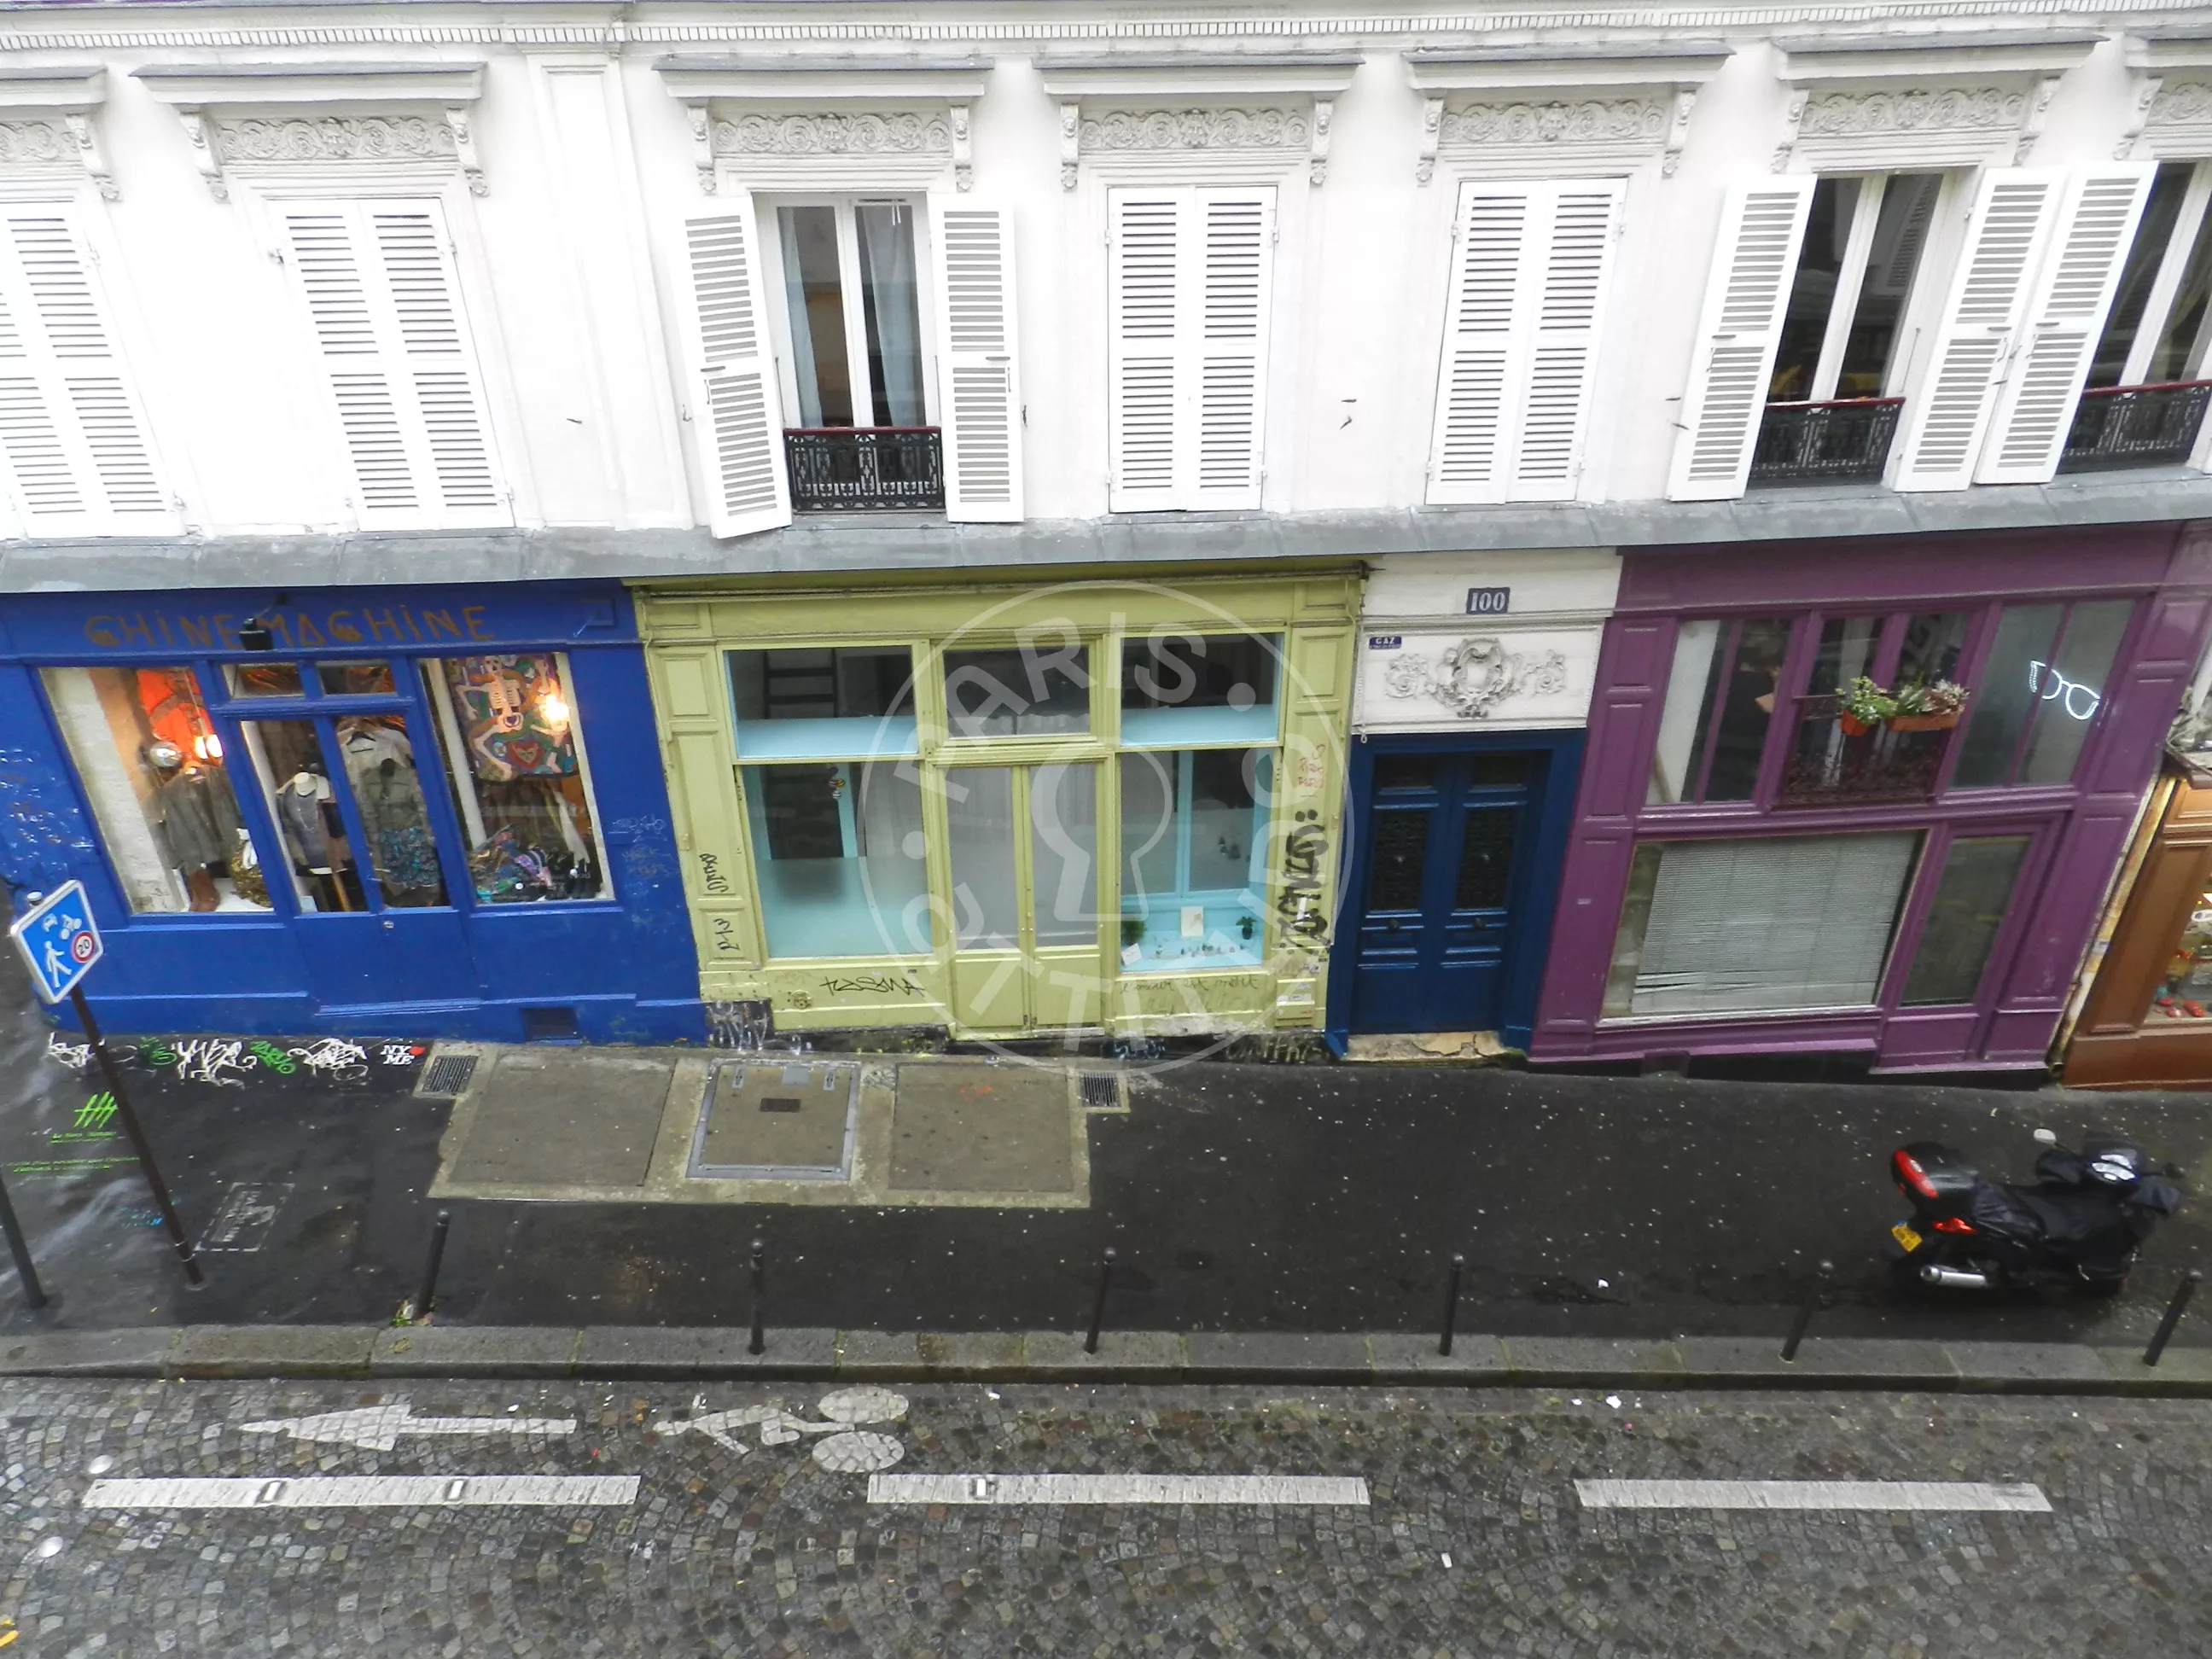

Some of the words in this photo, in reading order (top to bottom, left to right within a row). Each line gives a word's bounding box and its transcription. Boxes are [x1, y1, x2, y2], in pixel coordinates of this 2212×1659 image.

[1470, 591, 1505, 611] 100
[77, 939, 90, 955] 20
[381, 1045, 411, 1056] NY
[383, 1055, 415, 1065] ME
